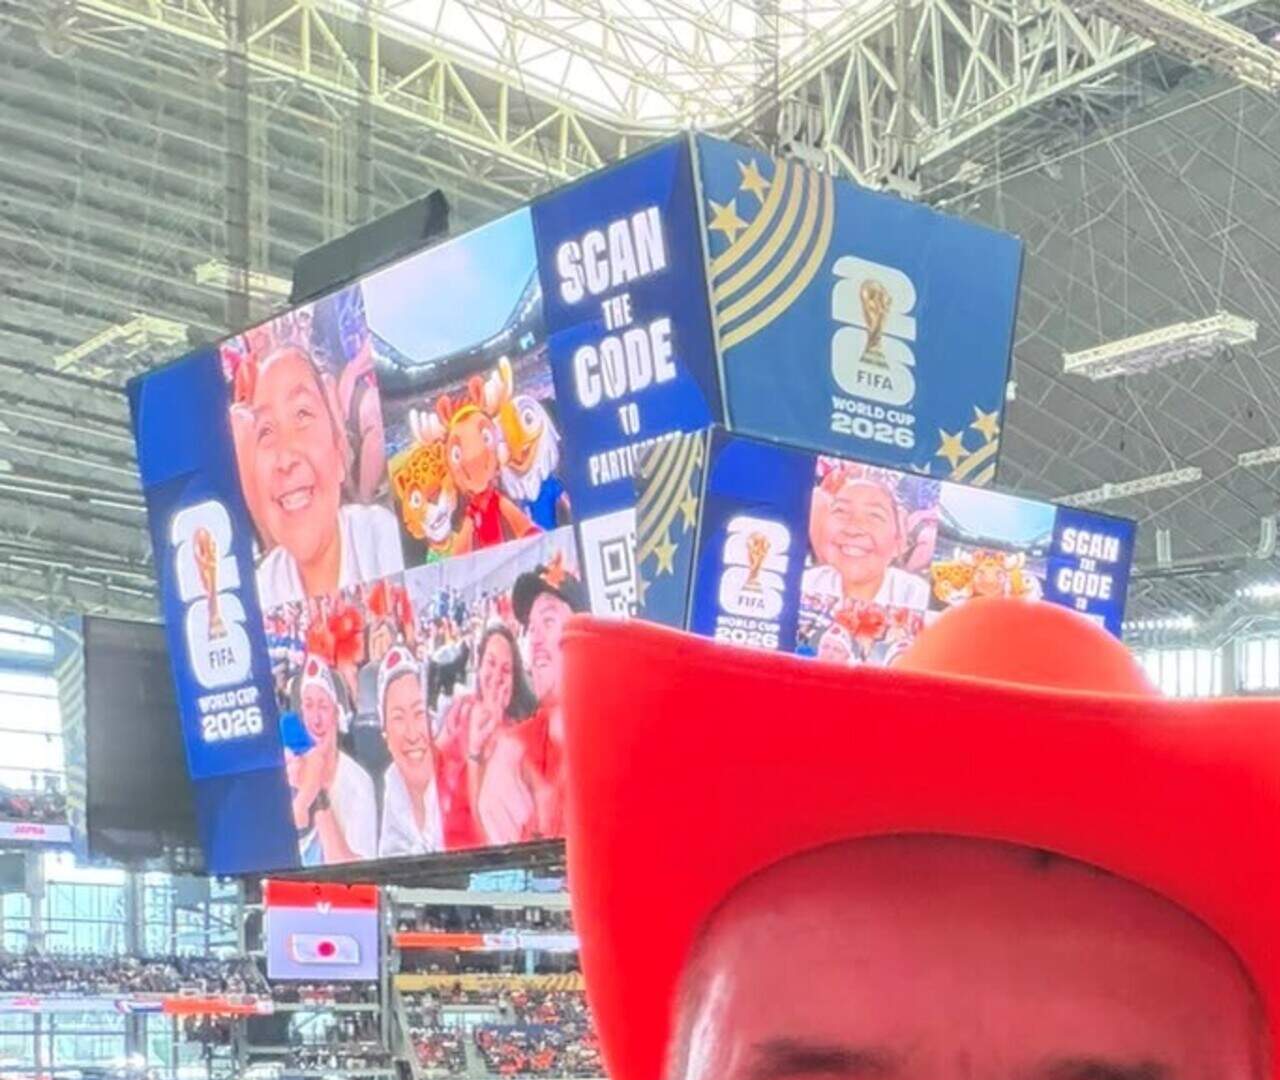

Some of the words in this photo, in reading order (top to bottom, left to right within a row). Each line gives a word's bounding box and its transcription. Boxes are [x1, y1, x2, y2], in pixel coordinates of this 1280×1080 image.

[557, 206, 667, 304] SCAN
[602, 293, 633, 331] THE
[574, 318, 677, 408] CODE
[857, 370, 893, 390] FIFA
[619, 403, 640, 435] TO
[832, 396, 884, 420] WORLD
[886, 409, 915, 426] CUP
[831, 412, 915, 448] 2026
[1061, 528, 1119, 562] SCAN
[1057, 568, 1113, 600] CODE
[738, 595, 765, 609] FIFA
[715, 627, 780, 649] 2026
[209, 648, 236, 670] FIFA
[198, 691, 237, 713] WORLD
[238, 686, 259, 708] CUP
[202, 707, 263, 742] 2026
